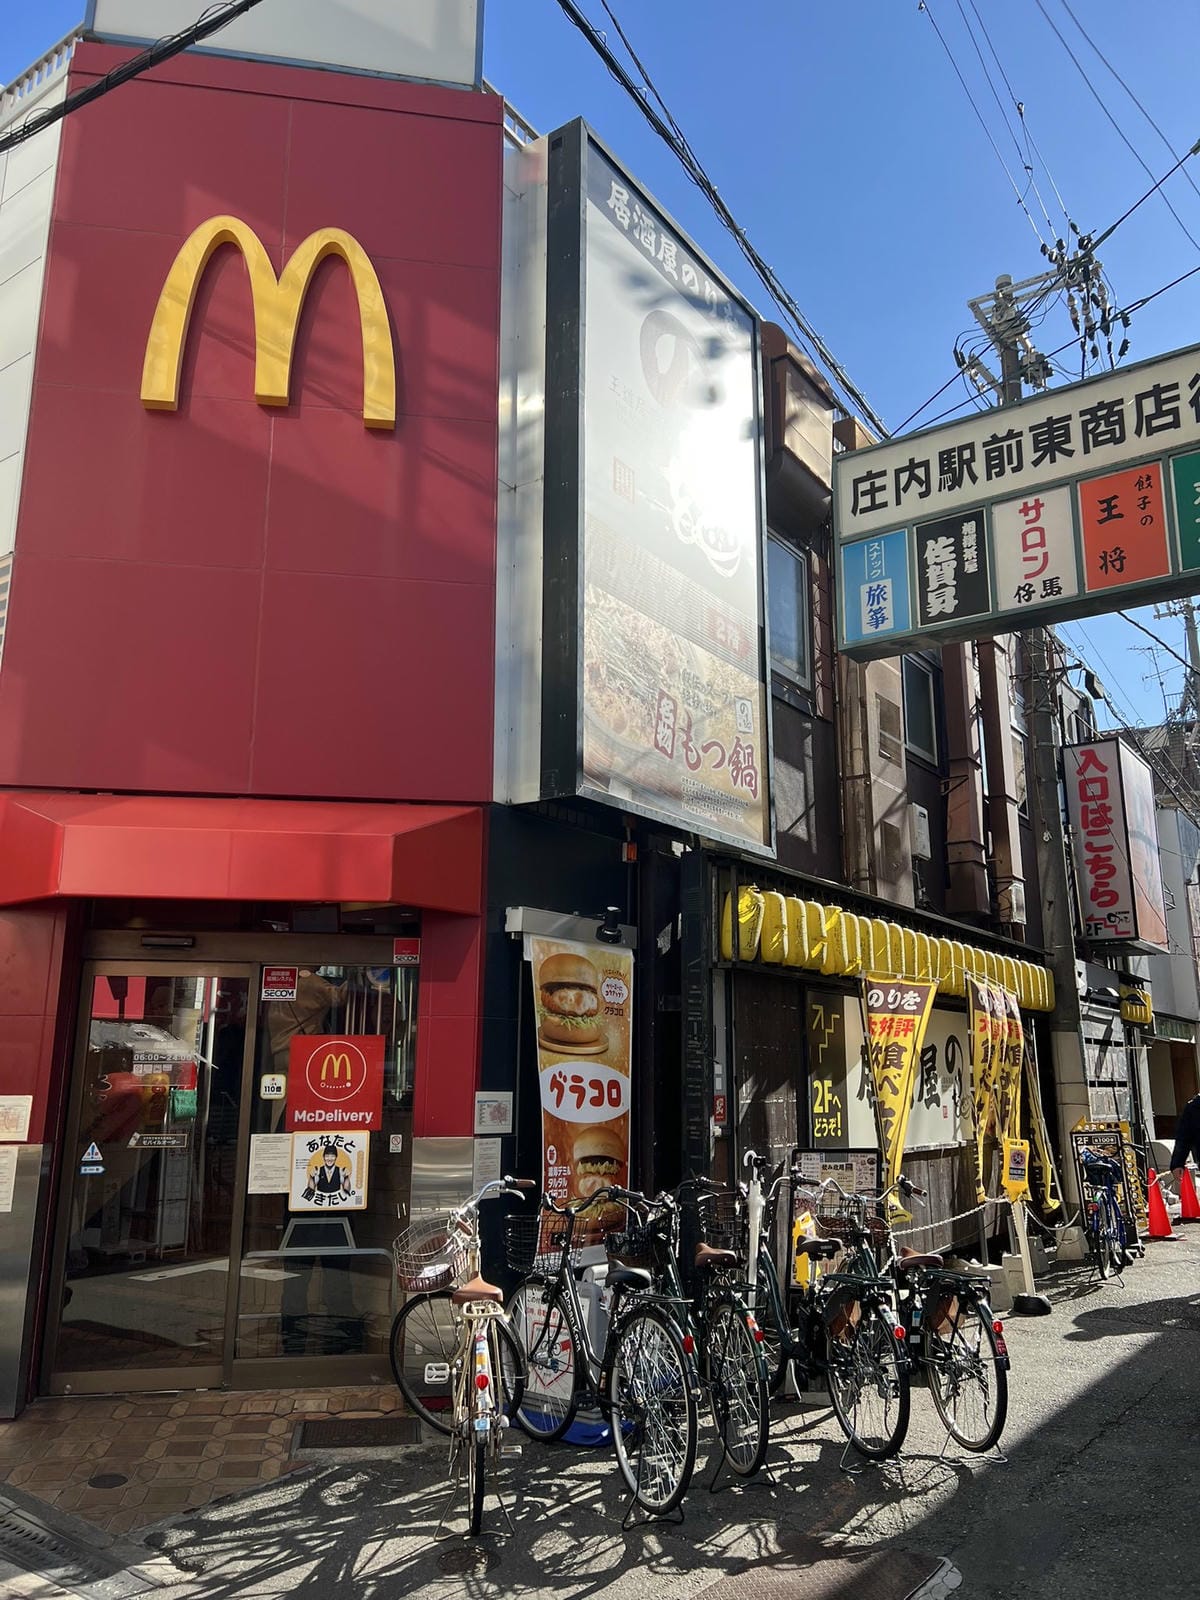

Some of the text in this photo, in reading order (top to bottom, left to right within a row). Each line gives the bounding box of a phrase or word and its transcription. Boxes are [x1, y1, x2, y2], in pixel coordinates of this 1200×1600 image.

[851, 372, 1200, 517] 庄内駅前東商店
[1134, 475, 1154, 527] 餃子の
[1018, 498, 1049, 580] サロン
[1096, 494, 1127, 575] 王将
[869, 542, 881, 579] スナック
[1014, 576, 1063, 604] 仔馬
[1076, 749, 1119, 908] 入口はこちら
[1086, 922, 1103, 936] 2F
[395, 954, 418, 962] SECOM
[264, 989, 294, 997] SECOM
[868, 989, 921, 1010] のりを
[549, 1070, 622, 1110] グラコロ
[813, 1080, 842, 1114] 2Fへ
[294, 1109, 373, 1124] McDelivery
[306, 1134, 356, 1153] あなたと
